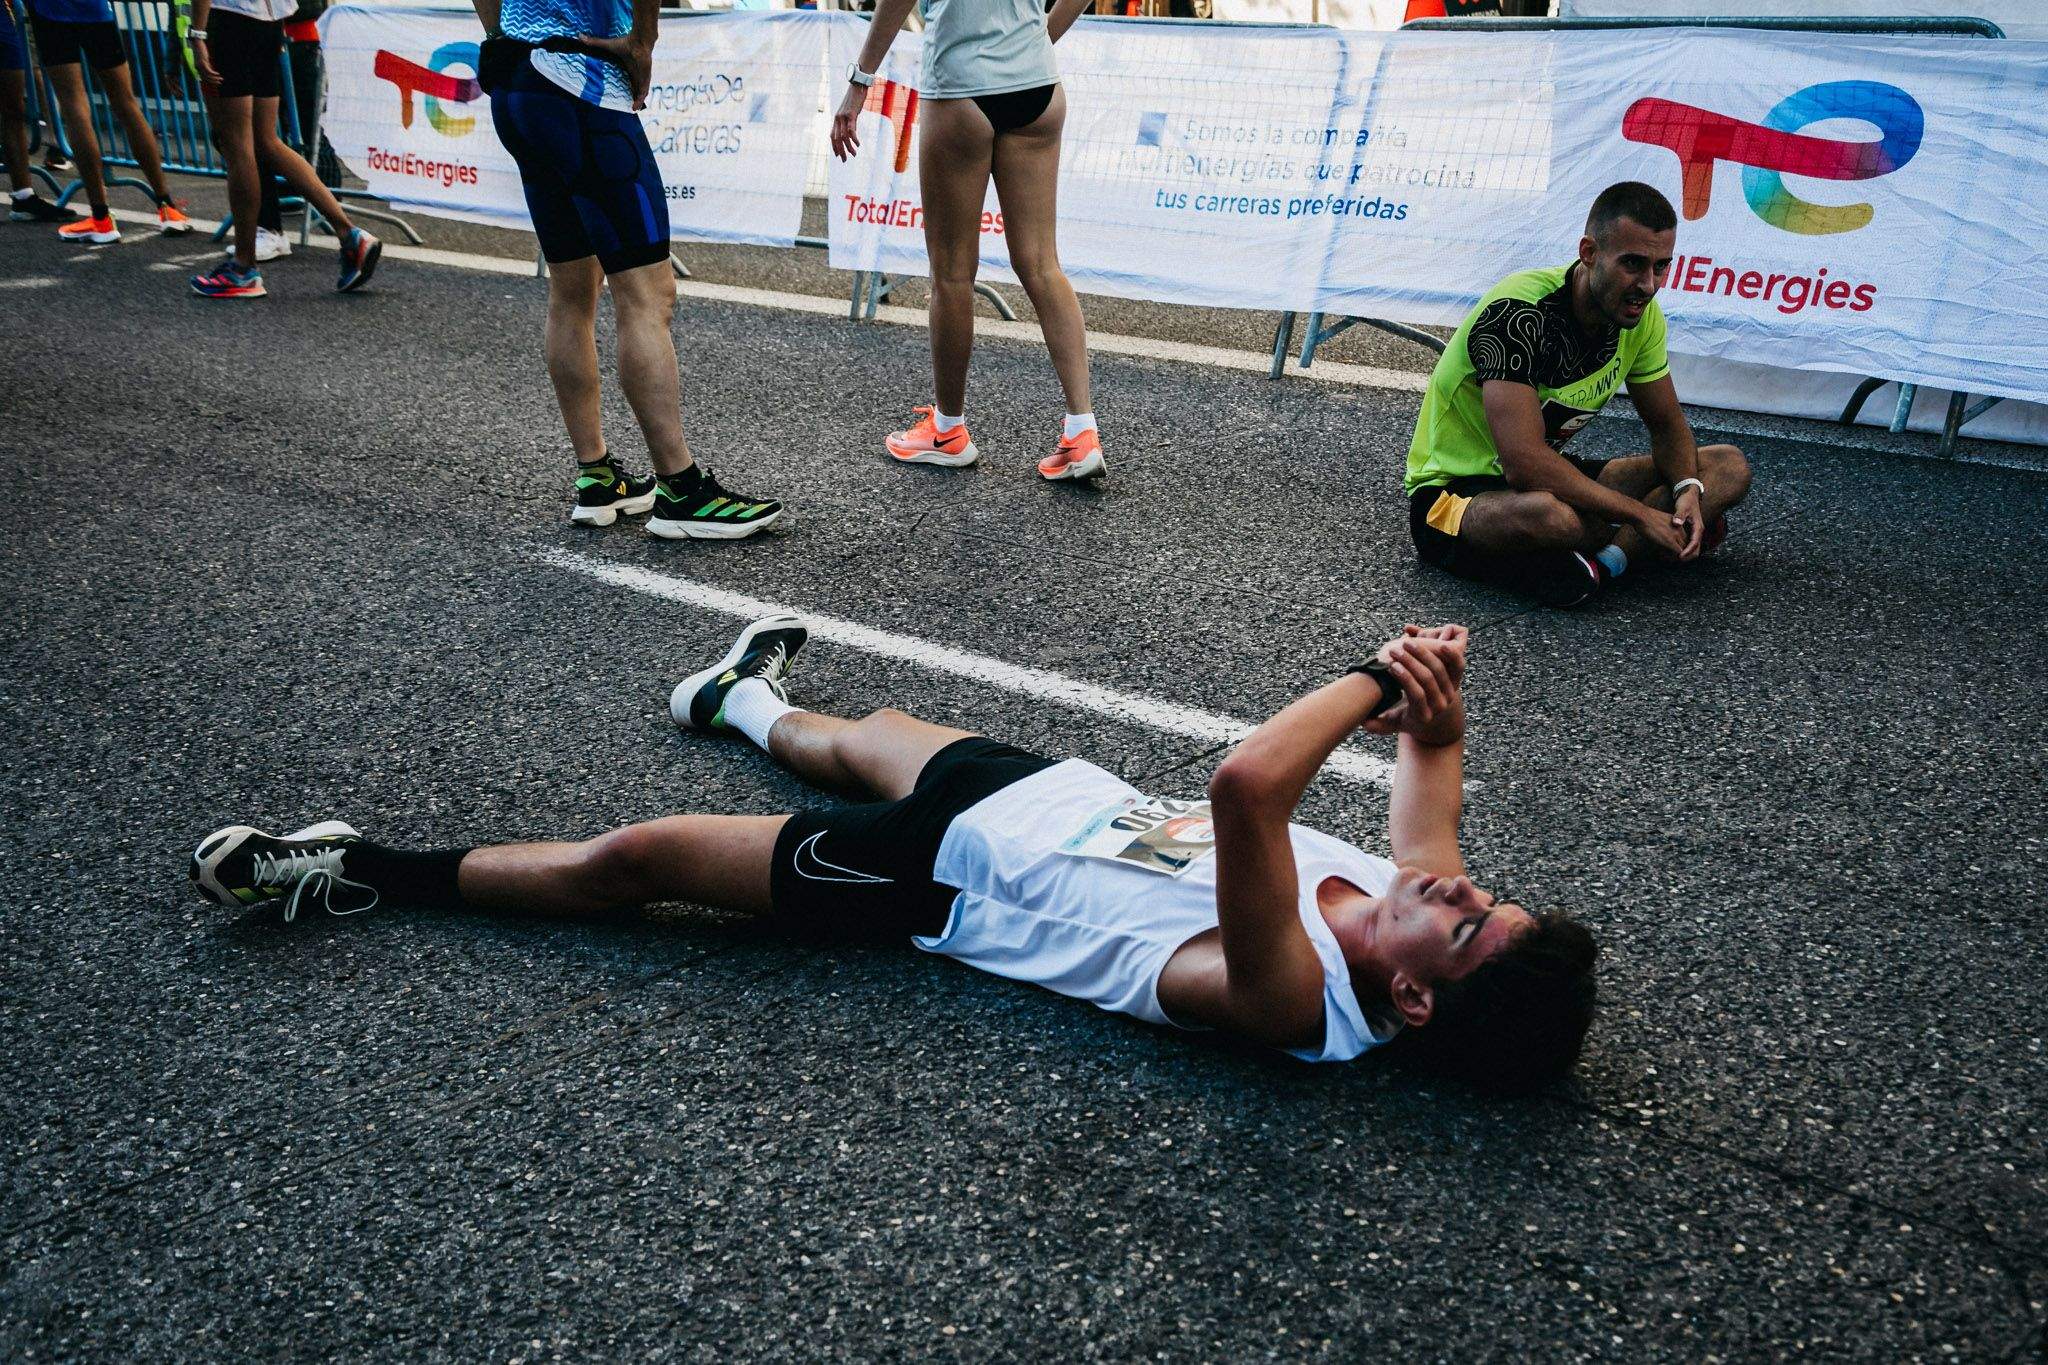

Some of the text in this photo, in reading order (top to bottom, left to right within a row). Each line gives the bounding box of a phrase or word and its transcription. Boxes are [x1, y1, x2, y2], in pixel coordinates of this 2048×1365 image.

[1184, 119, 1257, 143] Somos
[1264, 124, 1283, 145] la
[367, 147, 478, 187] TotalEnergies
[1304, 163, 1343, 184] que
[1350, 163, 1477, 188] patrocina
[845, 194, 1005, 234] TotalEnes
[1155, 188, 1409, 221] tus carreras preferidas
[1660, 254, 1878, 314] lEnergies
